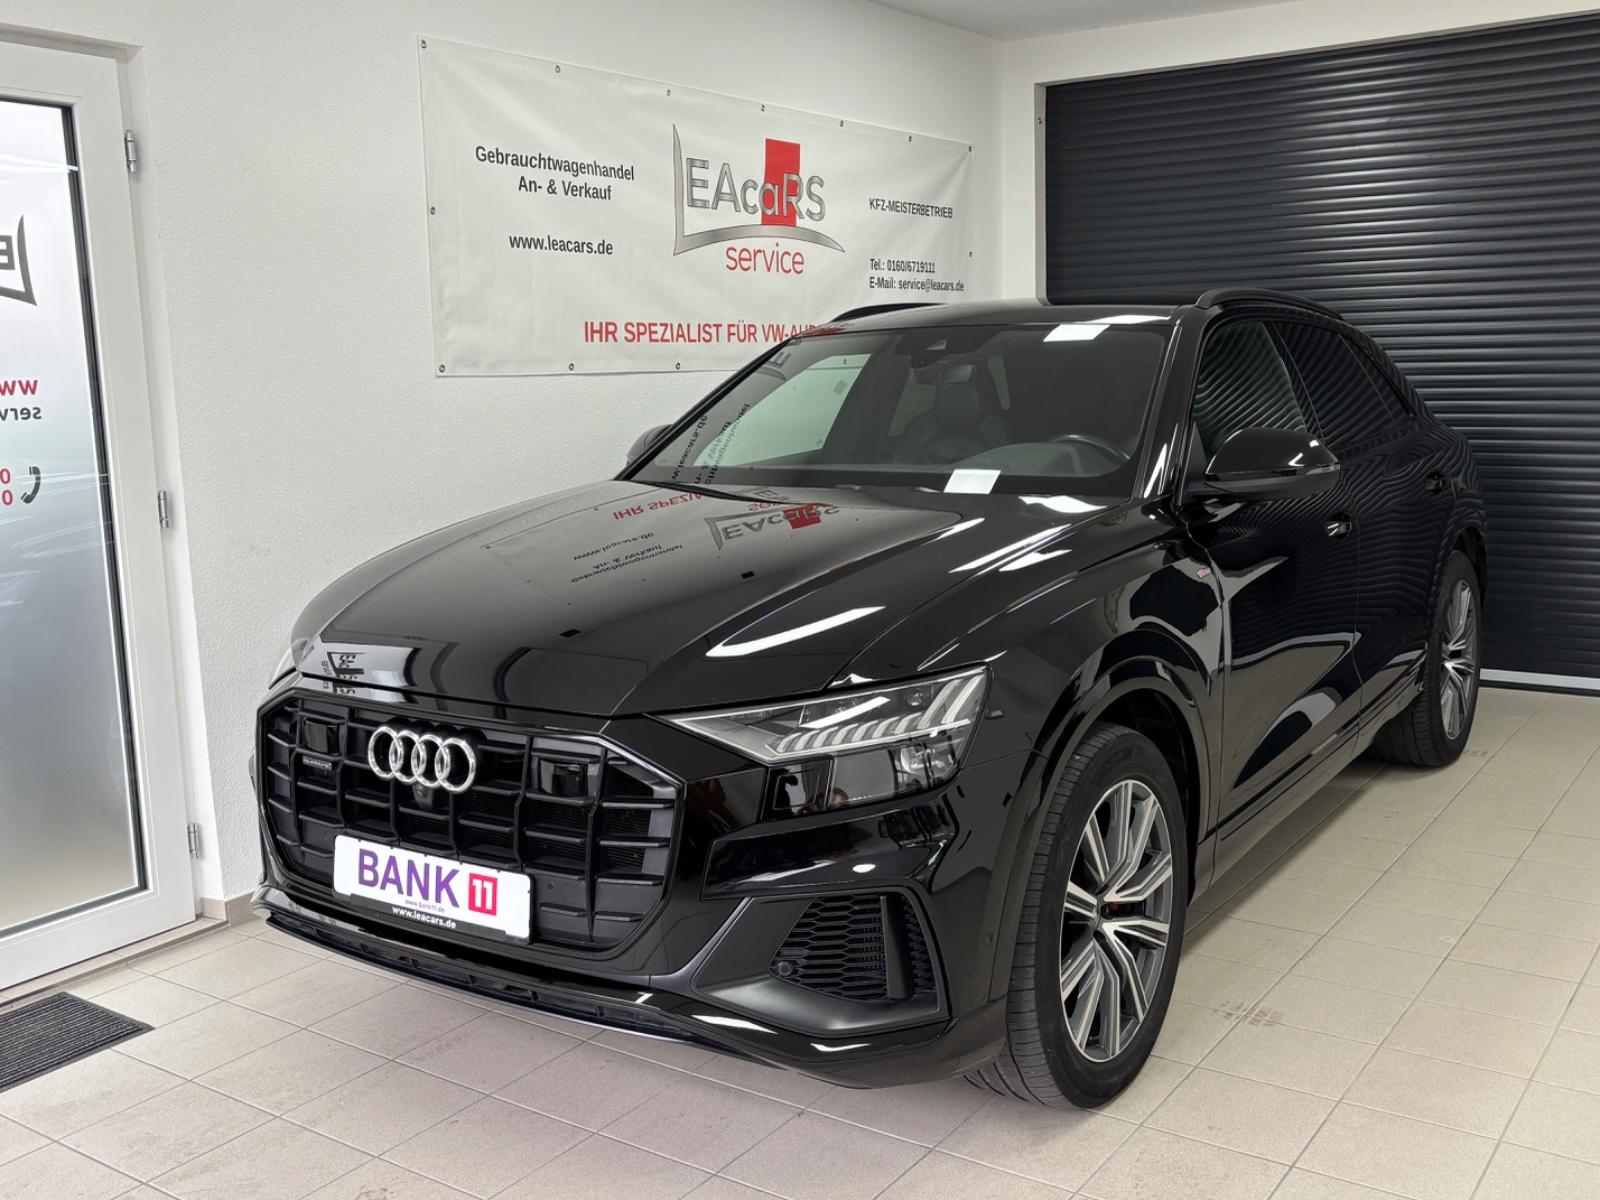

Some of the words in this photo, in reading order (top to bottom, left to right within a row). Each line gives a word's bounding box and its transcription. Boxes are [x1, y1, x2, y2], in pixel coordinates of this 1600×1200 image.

[475, 145, 635, 181] Gebrauchtwagenhandel
[518, 175, 543, 193] An-
[546, 179, 558, 195] &
[562, 180, 612, 200] Verkauf
[869, 198, 953, 219] KFZ-MEISTERBETRIEB
[509, 234, 613, 256] www.leacars.de
[725, 243, 804, 275] service
[870, 258, 885, 271] Tel.:
[887, 259, 936, 274] 0160/6719111
[869, 276, 896, 289] E-Mail:
[898, 277, 964, 293] service@leacars.de
[584, 321, 618, 343] IHR
[624, 322, 722, 343] SPEZIALIST
[727, 320, 758, 343] FÜR
[358, 848, 460, 908] BANK
[391, 905, 457, 930] www.leacars.de
